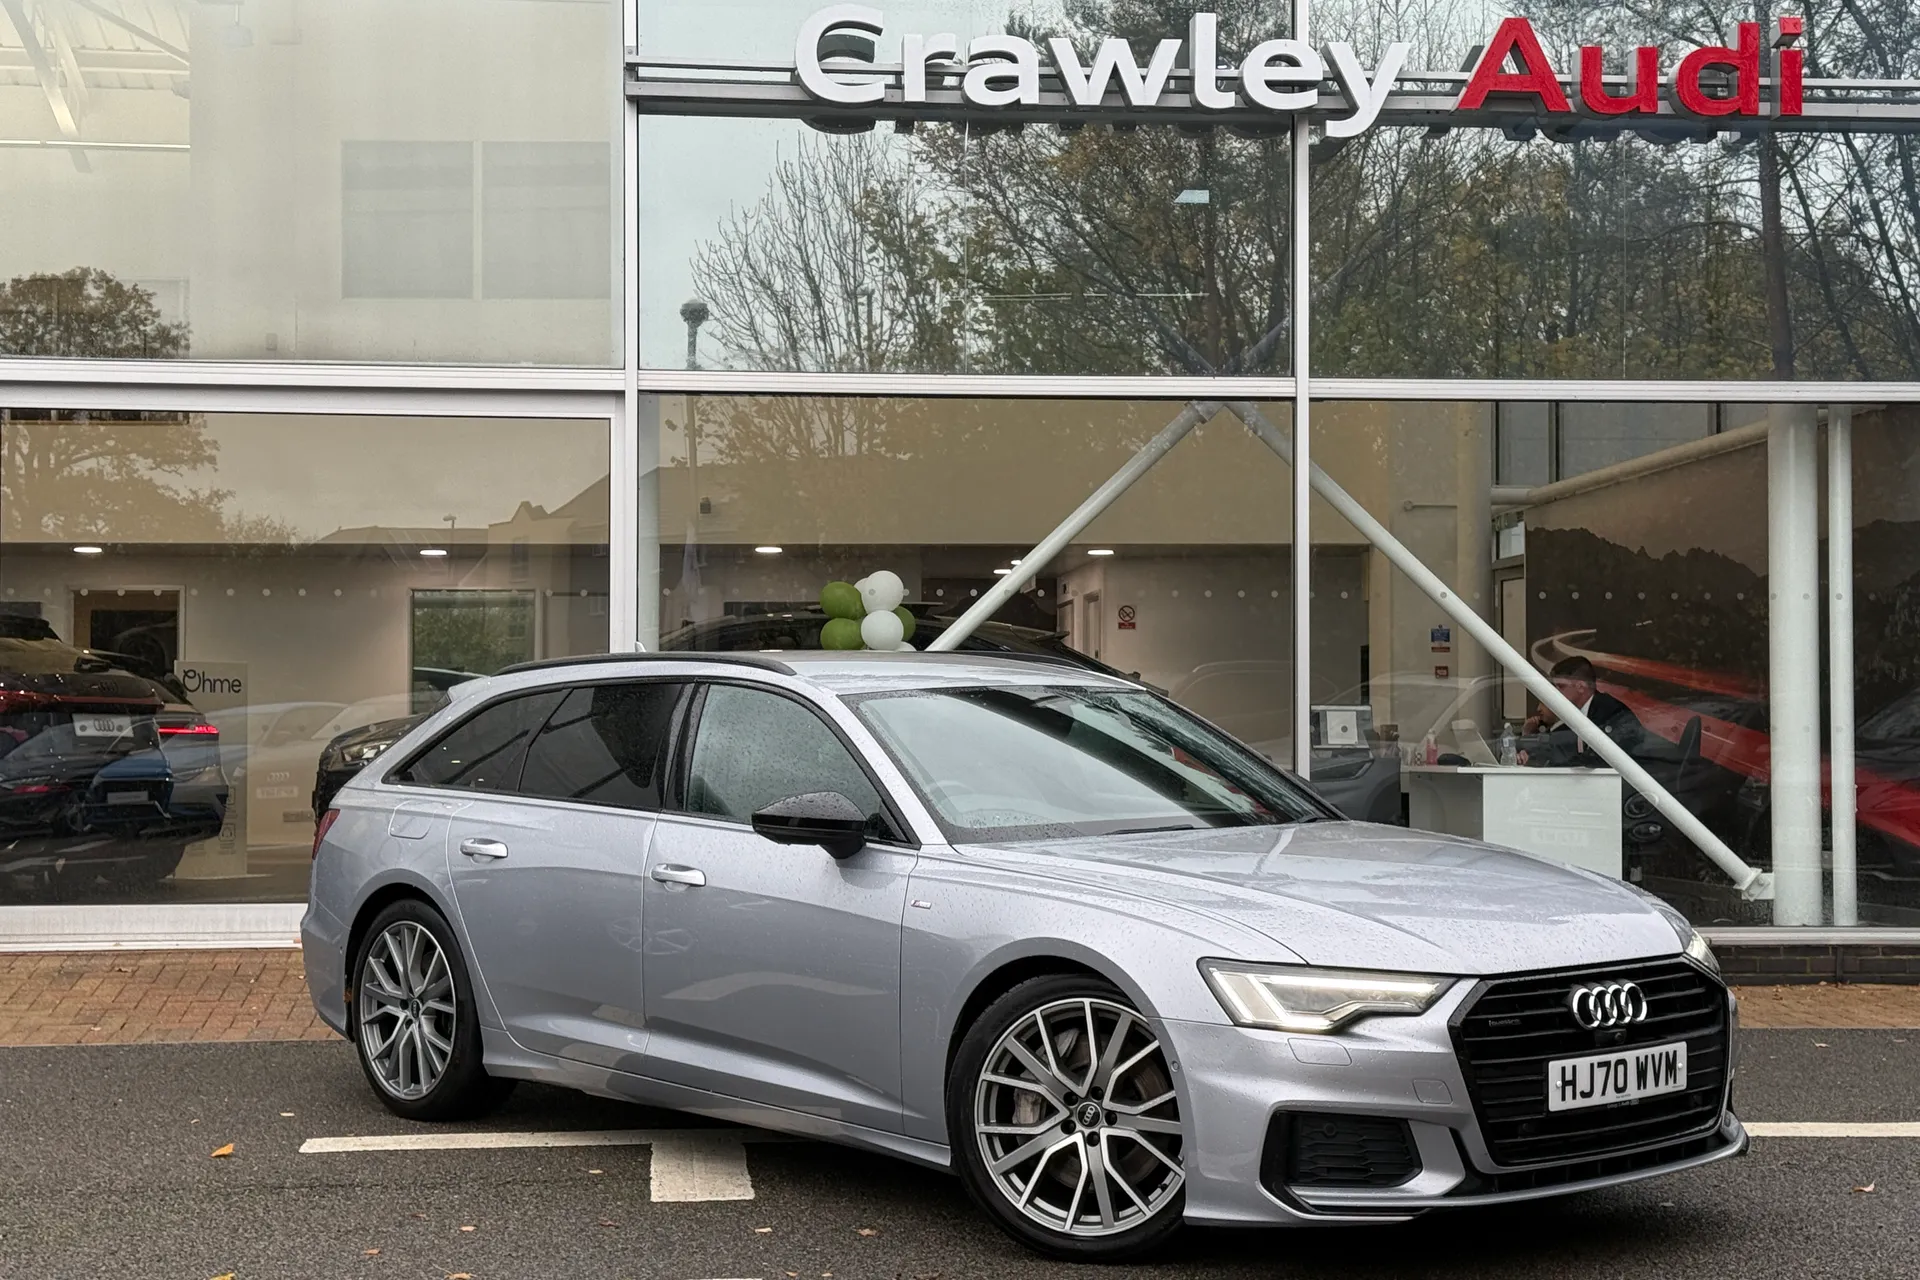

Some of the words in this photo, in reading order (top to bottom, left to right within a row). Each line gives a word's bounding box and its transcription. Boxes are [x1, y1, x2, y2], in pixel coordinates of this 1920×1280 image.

[795, 4, 1411, 137] Crawley
[1455, 17, 1803, 116] Audi
[183, 669, 242, 693] Ohme
[1561, 1058, 1628, 1102] HJ70
[1635, 1049, 1678, 1091] WVM
